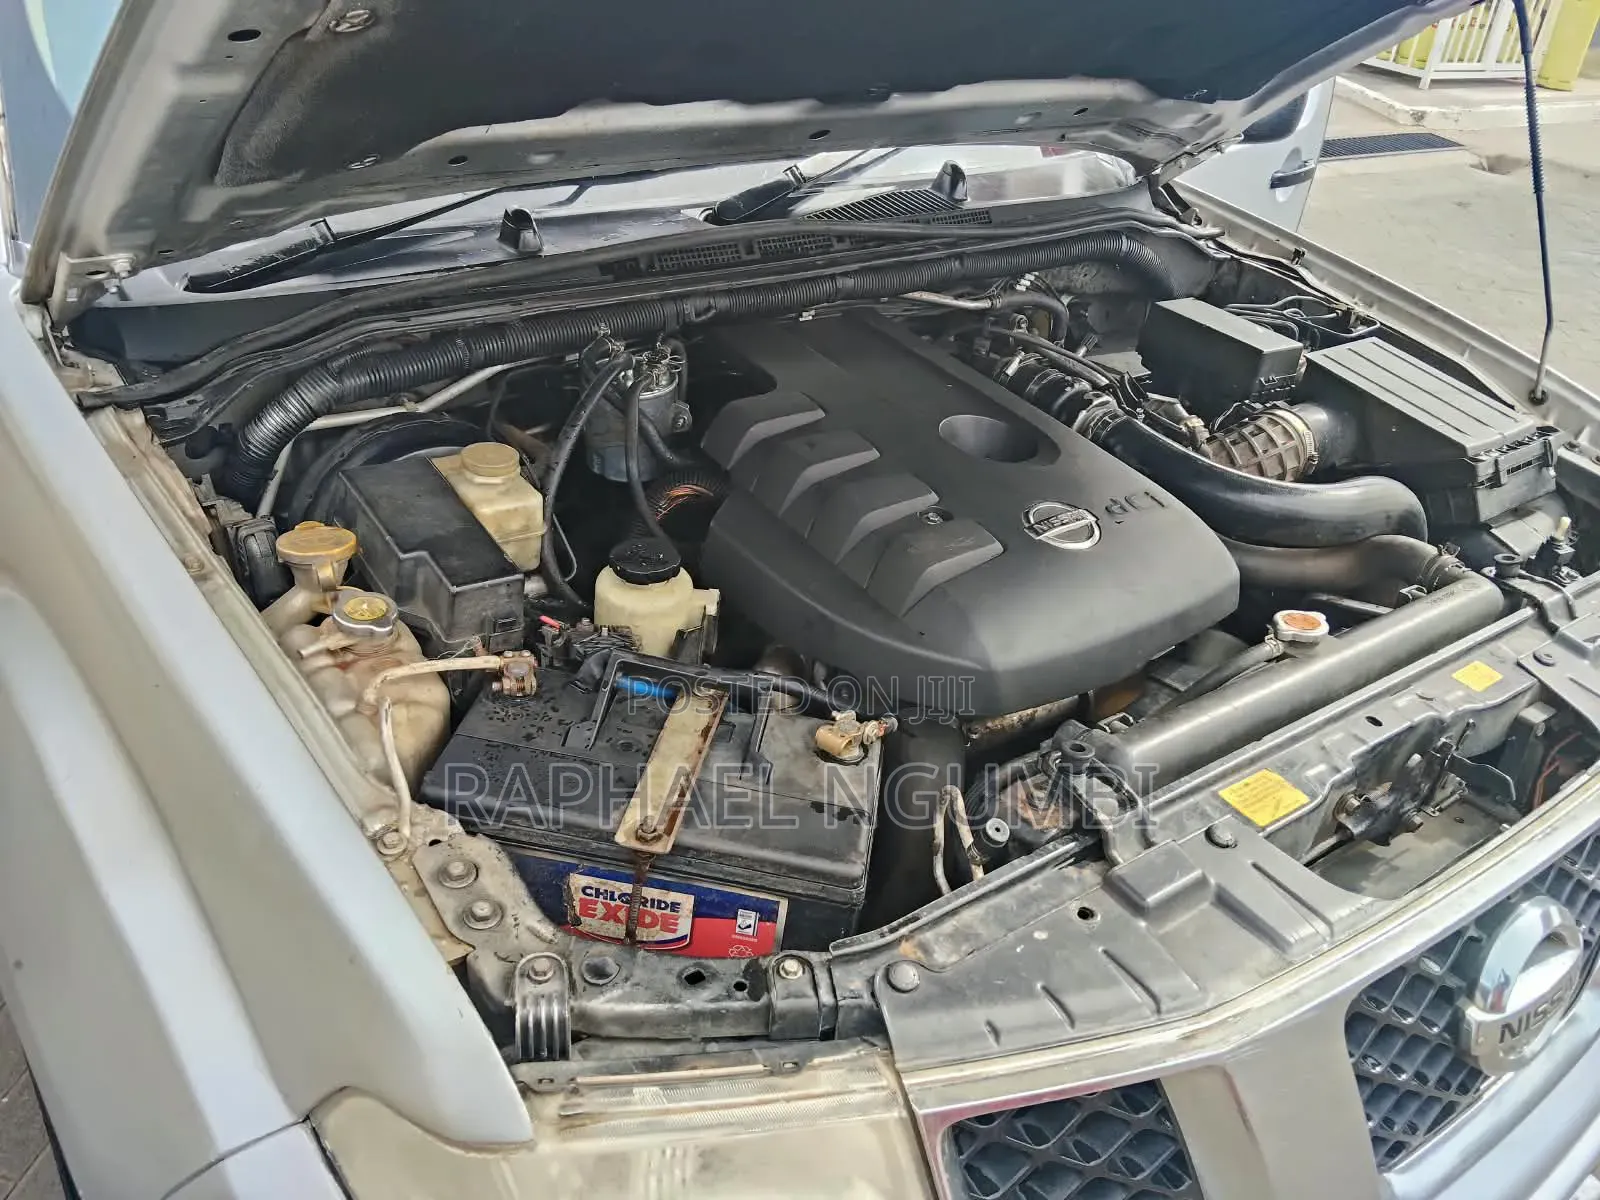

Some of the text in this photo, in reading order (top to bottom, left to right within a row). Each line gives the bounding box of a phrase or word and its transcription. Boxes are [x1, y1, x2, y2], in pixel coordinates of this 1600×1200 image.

[1033, 509, 1088, 533] NISS
[581, 885, 681, 913] CHLORIDE
[1498, 978, 1572, 1045] NISS
